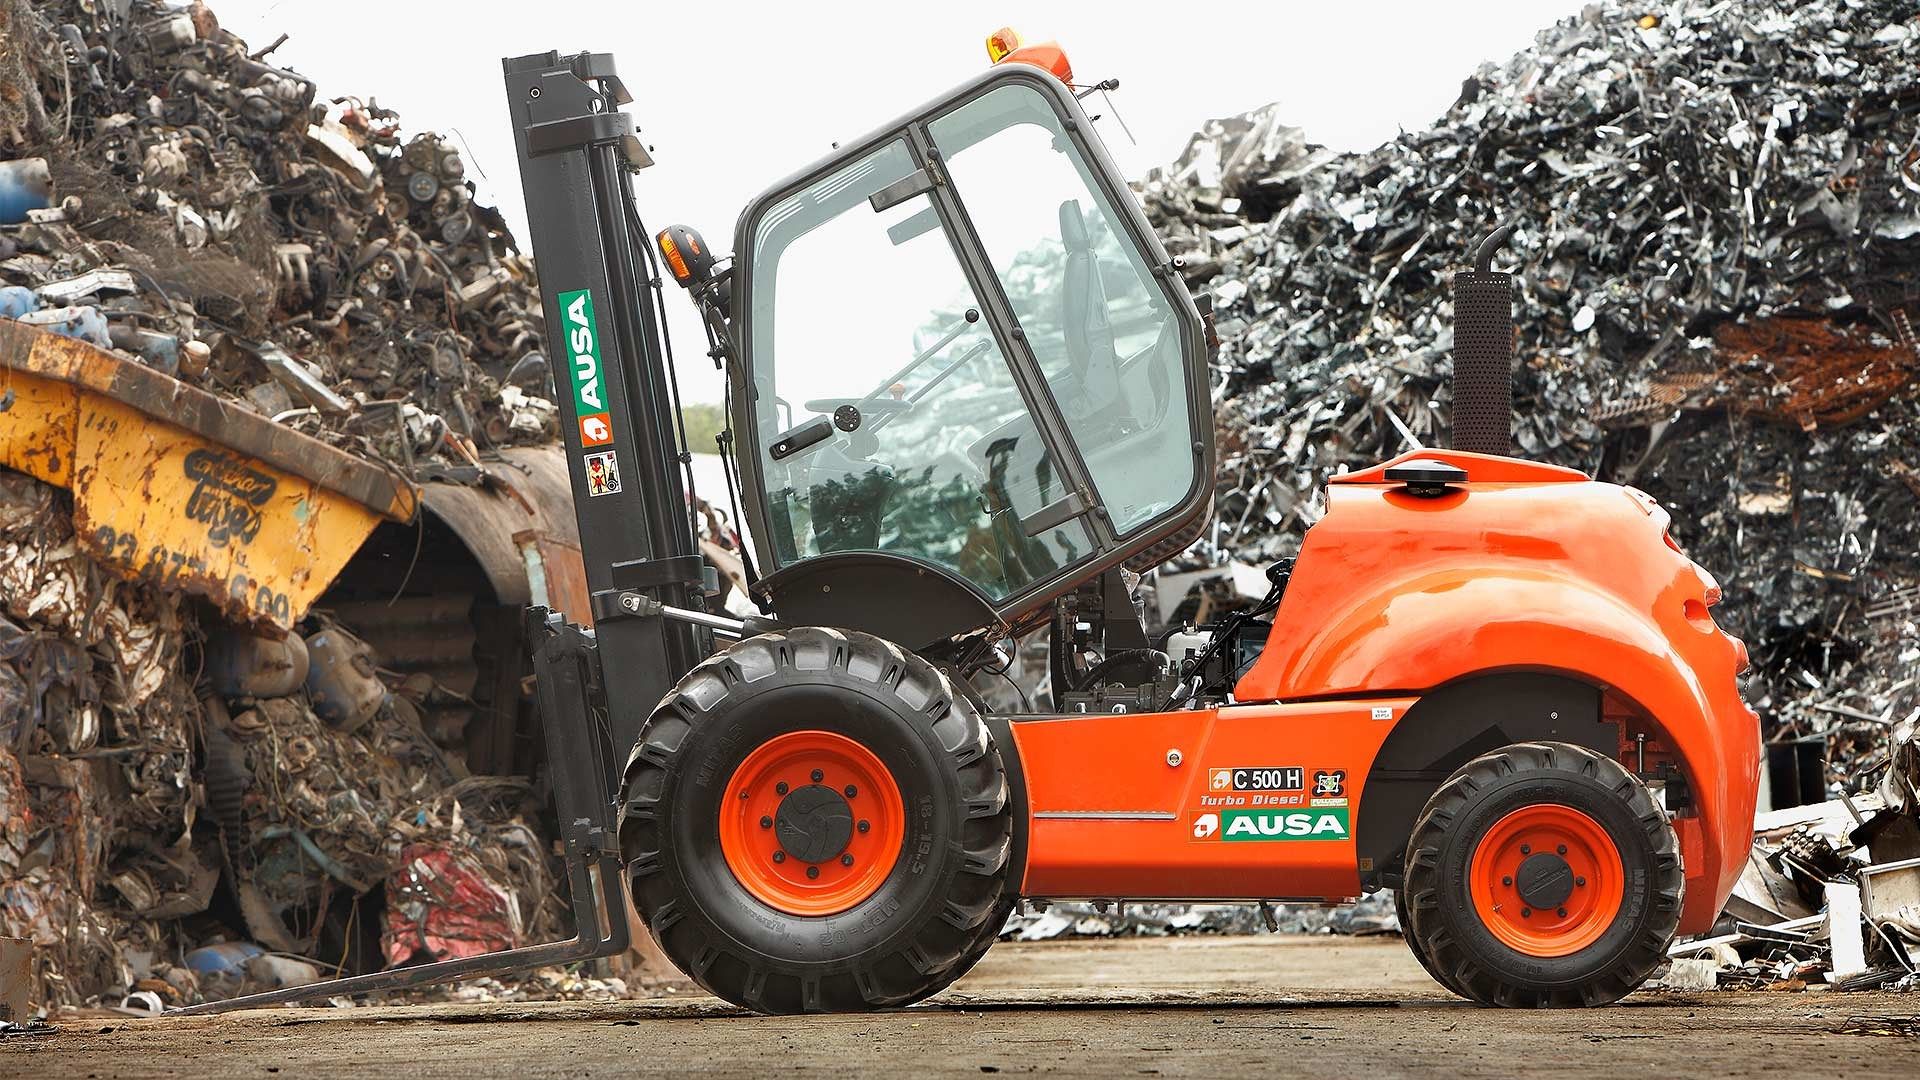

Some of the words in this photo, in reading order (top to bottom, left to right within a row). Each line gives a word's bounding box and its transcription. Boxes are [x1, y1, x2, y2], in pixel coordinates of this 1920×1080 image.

[567, 294, 602, 409] AUSA
[1234, 771, 1247, 789] C
[1252, 770, 1282, 789] 500
[1286, 769, 1300, 788] H
[1200, 795, 1245, 806] Turbo
[1252, 794, 1304, 805] Diesel
[1225, 813, 1346, 836] AUSA
[1623, 868, 1645, 931] MITAS
